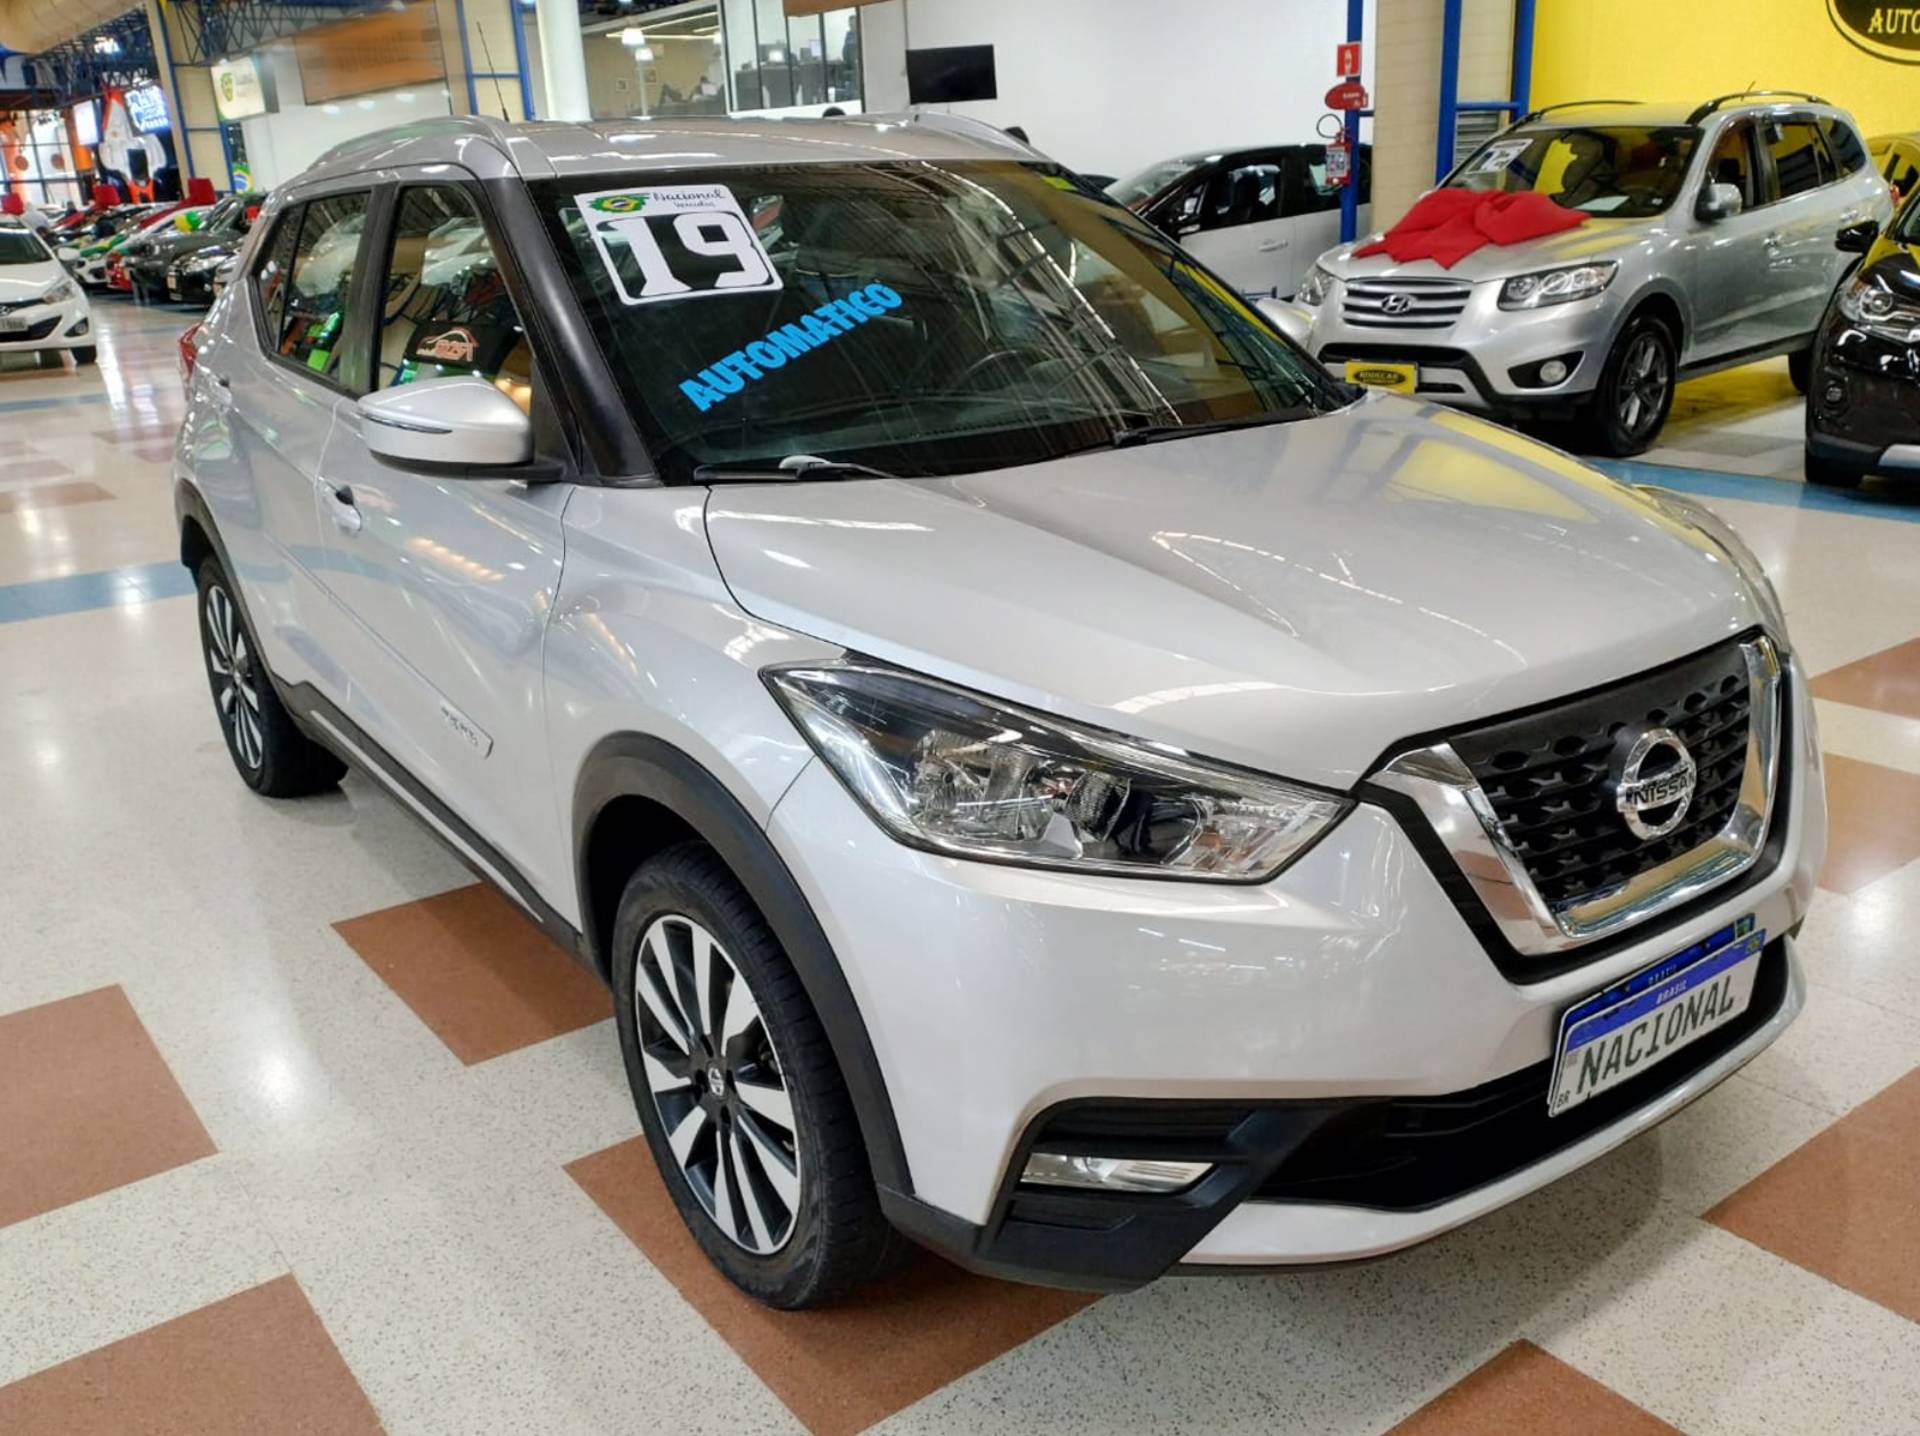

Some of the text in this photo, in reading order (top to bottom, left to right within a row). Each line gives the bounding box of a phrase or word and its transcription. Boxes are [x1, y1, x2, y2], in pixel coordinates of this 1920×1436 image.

[652, 189, 726, 201] Nacional
[597, 210, 770, 298] 19
[678, 283, 904, 413] AUTOMATICO
[1576, 975, 1734, 1095] NACIONAL
